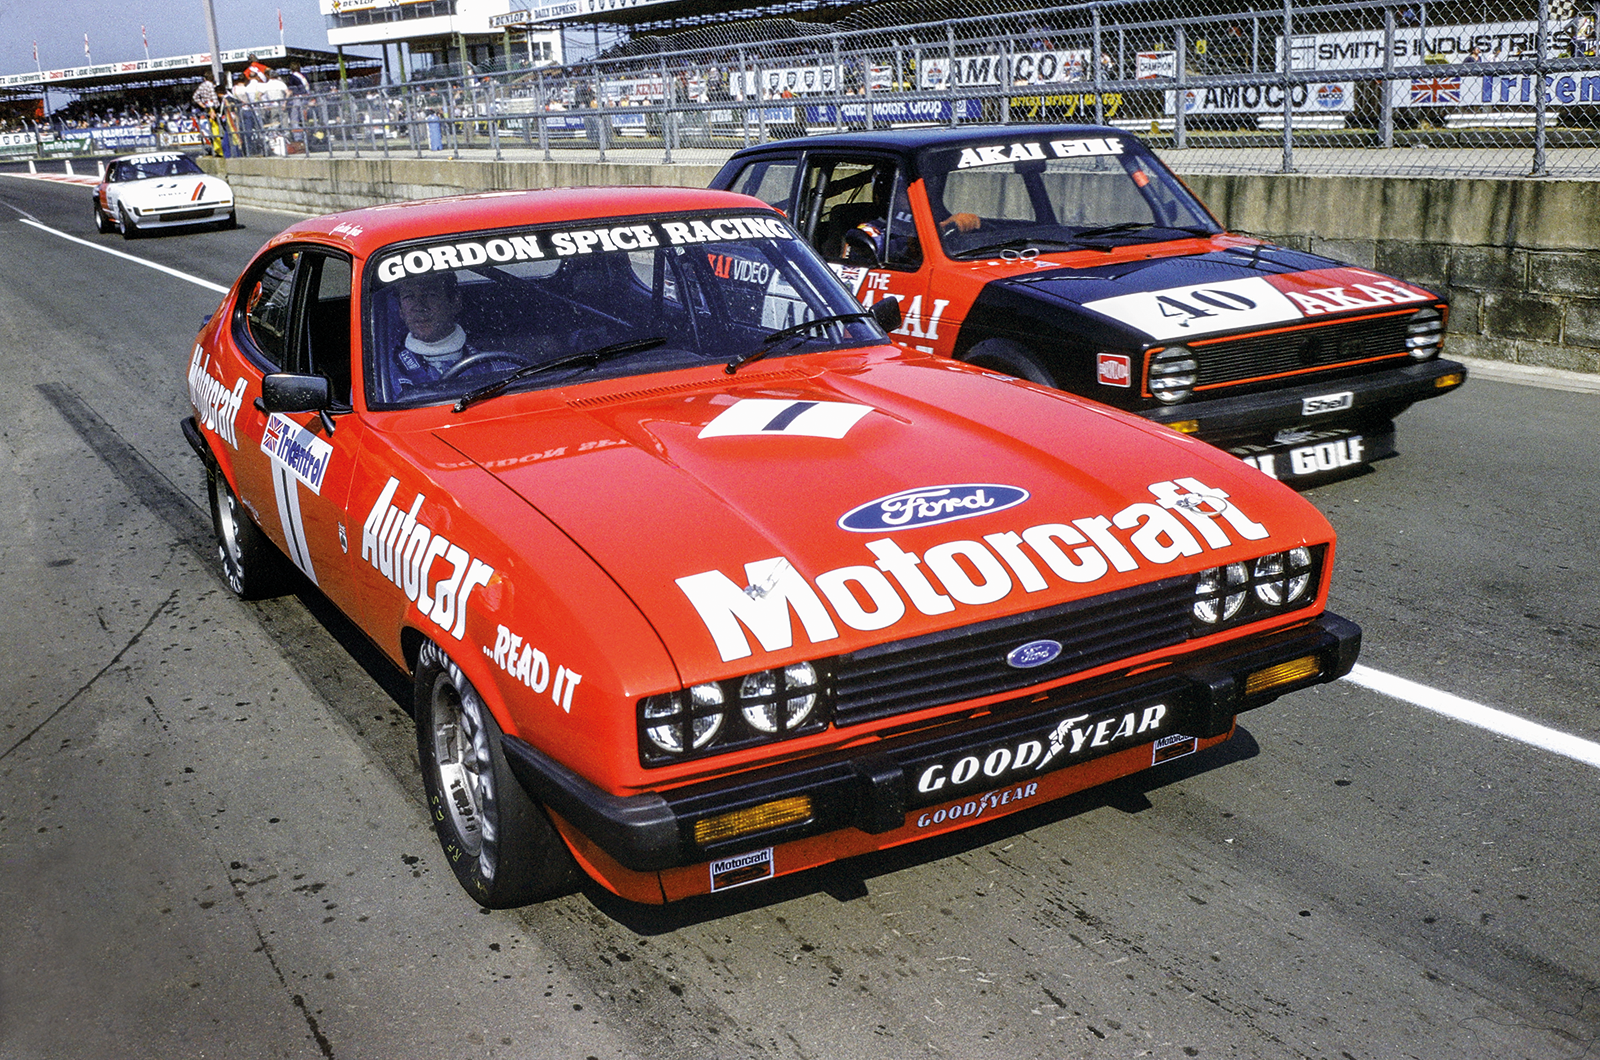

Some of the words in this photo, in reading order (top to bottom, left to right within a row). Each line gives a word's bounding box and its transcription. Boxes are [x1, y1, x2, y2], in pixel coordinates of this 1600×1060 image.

[495, 12, 524, 26] DUNLOP
[534, 8, 550, 19] DAILY
[552, 3, 577, 17] EXPRESS
[1319, 40, 1407, 61] SMITHS
[63, 69, 74, 77] GTX
[136, 61, 148, 70] GTX
[1140, 61, 1172, 72] CHAMPION
[1203, 83, 1309, 109] AMOCO
[131, 154, 181, 166] PENTAX
[957, 143, 1047, 168] AKAI
[1050, 138, 1124, 158] GOLF
[378, 235, 544, 283] GORDON
[551, 225, 659, 256] SPICE
[662, 218, 793, 244] RACING
[733, 260, 770, 285] VIDEO
[868, 272, 891, 290] THE
[1155, 289, 1257, 322] 40
[1285, 281, 1428, 315] AKAI
[277, 423, 328, 488] Tricentrol
[1289, 435, 1364, 475] GOLF
[880, 487, 996, 525] Ford
[361, 475, 495, 641] Autocar
[674, 477, 1270, 663] Motorcraft
[1020, 646, 1050, 663] Ford
[552, 664, 582, 714] IT
[714, 851, 768, 874] Motorcraft
